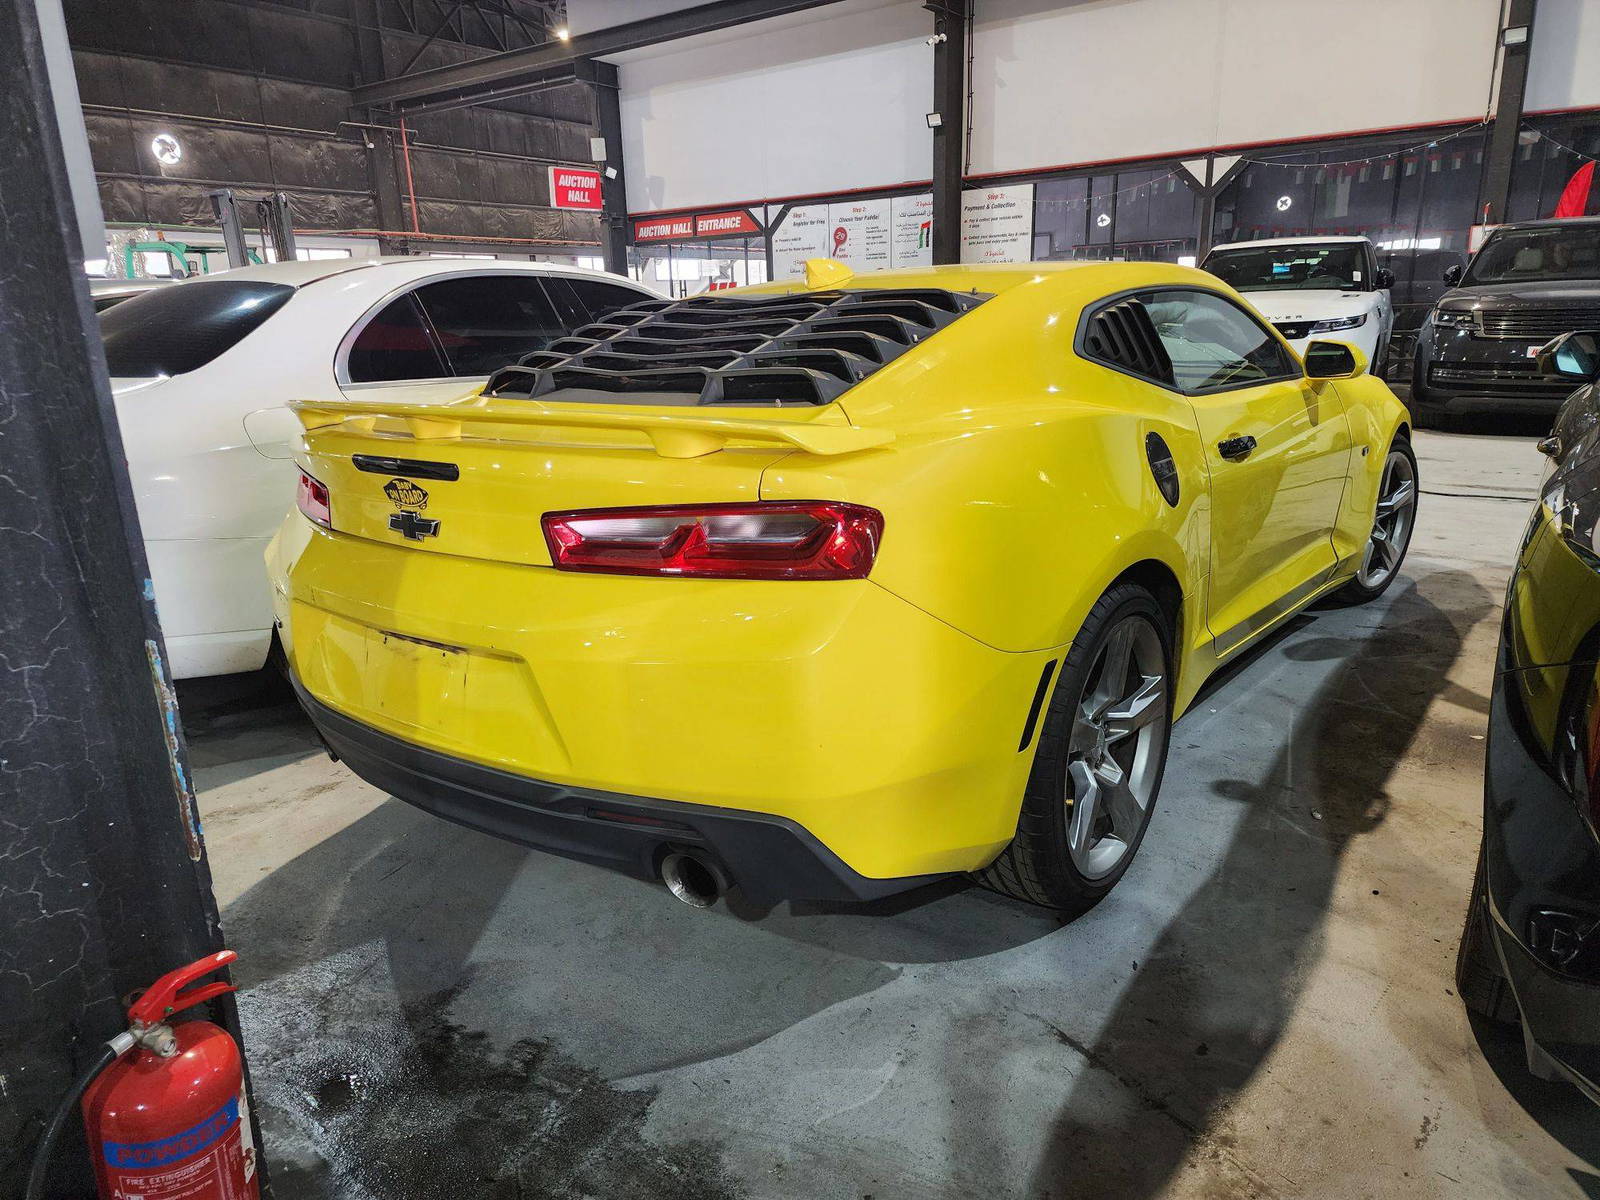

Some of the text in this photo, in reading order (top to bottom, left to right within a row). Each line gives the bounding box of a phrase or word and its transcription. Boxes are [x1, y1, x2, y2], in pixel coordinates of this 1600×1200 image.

[558, 174, 597, 189] AUCTION
[567, 189, 591, 203] HALL
[987, 193, 999, 201] Step
[964, 204, 986, 212] Payment
[991, 202, 1016, 210] Collection
[638, 216, 742, 238] AUCTION HALL ENTRANCE
[392, 480, 412, 489] BABY
[388, 489, 424, 504] ON BOARD
[117, 1112, 229, 1163] POWDER
[126, 1156, 211, 1186] FIRE EXTINGUISHER
